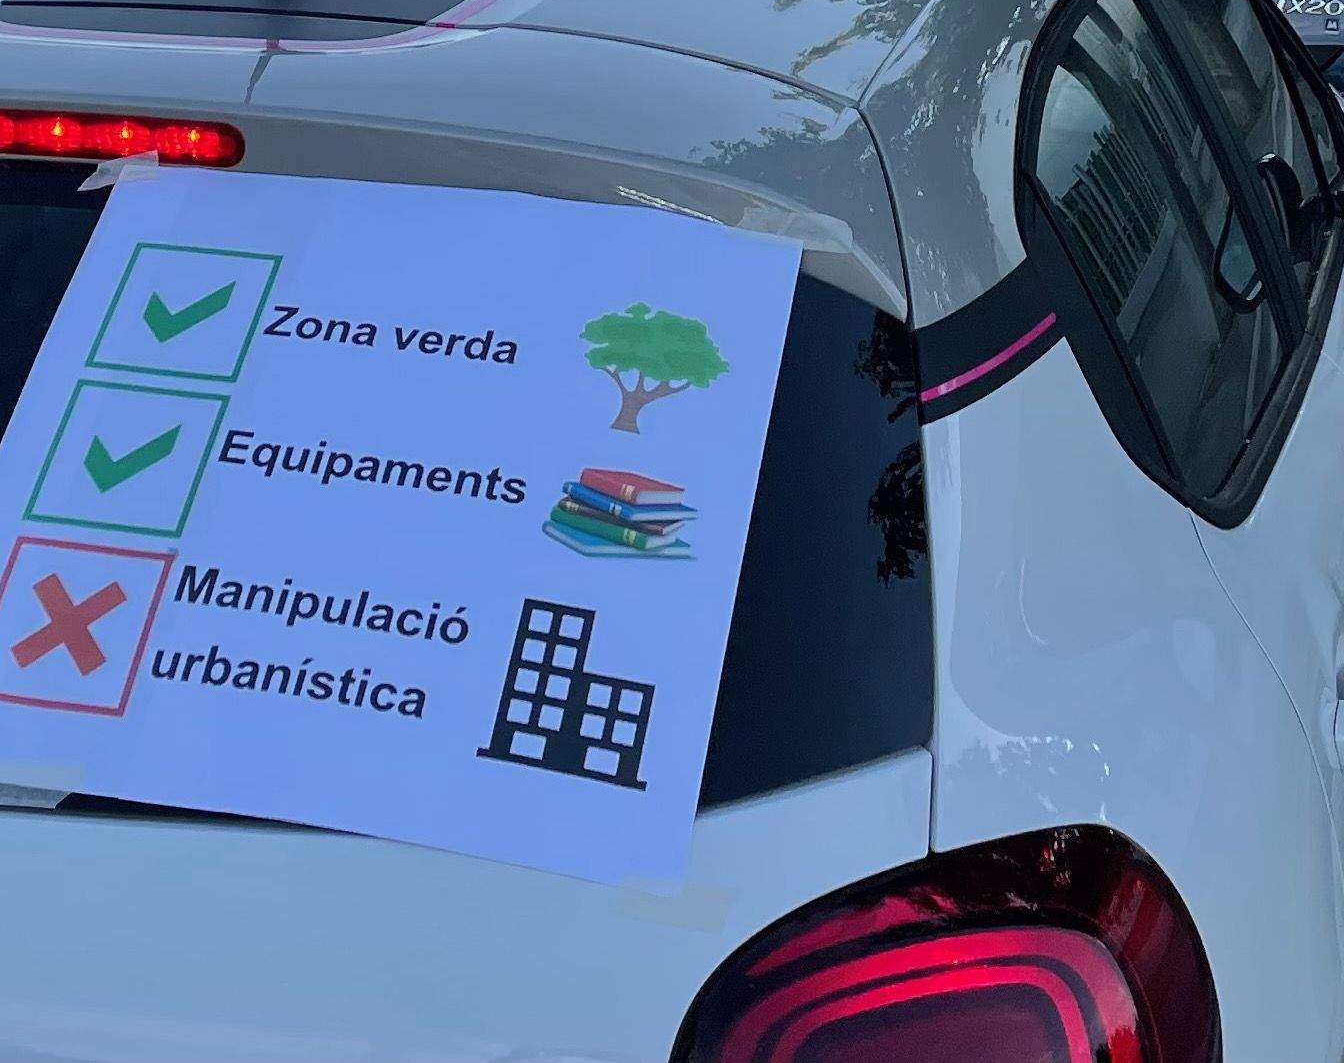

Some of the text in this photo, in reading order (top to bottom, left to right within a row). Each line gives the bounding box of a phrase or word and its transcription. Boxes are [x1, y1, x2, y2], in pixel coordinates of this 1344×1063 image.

[263, 305, 519, 365] Zona verda
[217, 429, 527, 505] Equipaments
[173, 565, 469, 645] Manipulació
[150, 645, 426, 719] urbanística
